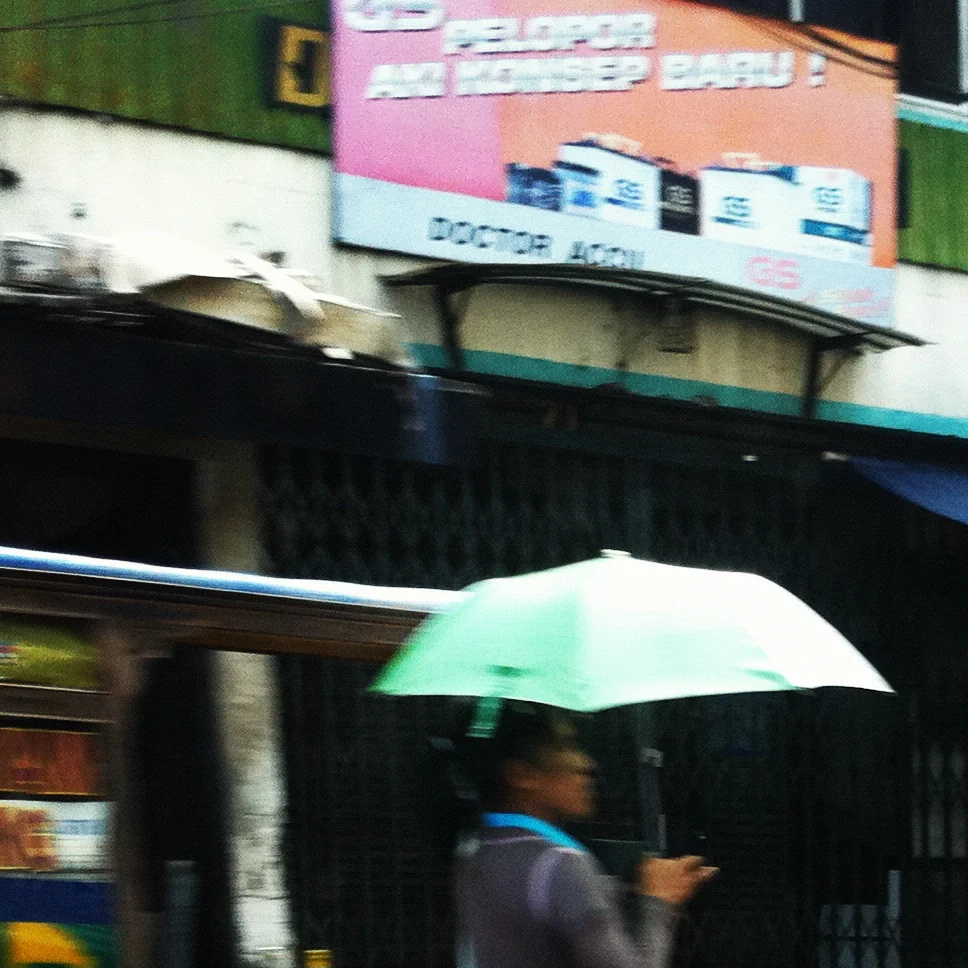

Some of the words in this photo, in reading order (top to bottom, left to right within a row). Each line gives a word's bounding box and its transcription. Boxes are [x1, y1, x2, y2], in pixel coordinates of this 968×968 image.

[442, 12, 656, 56] PELOPOR
[363, 60, 447, 100] AKI
[454, 55, 652, 97] KONSEP
[660, 50, 797, 91] BARU
[429, 216, 553, 259] DOCTOR
[744, 255, 800, 290] GS
